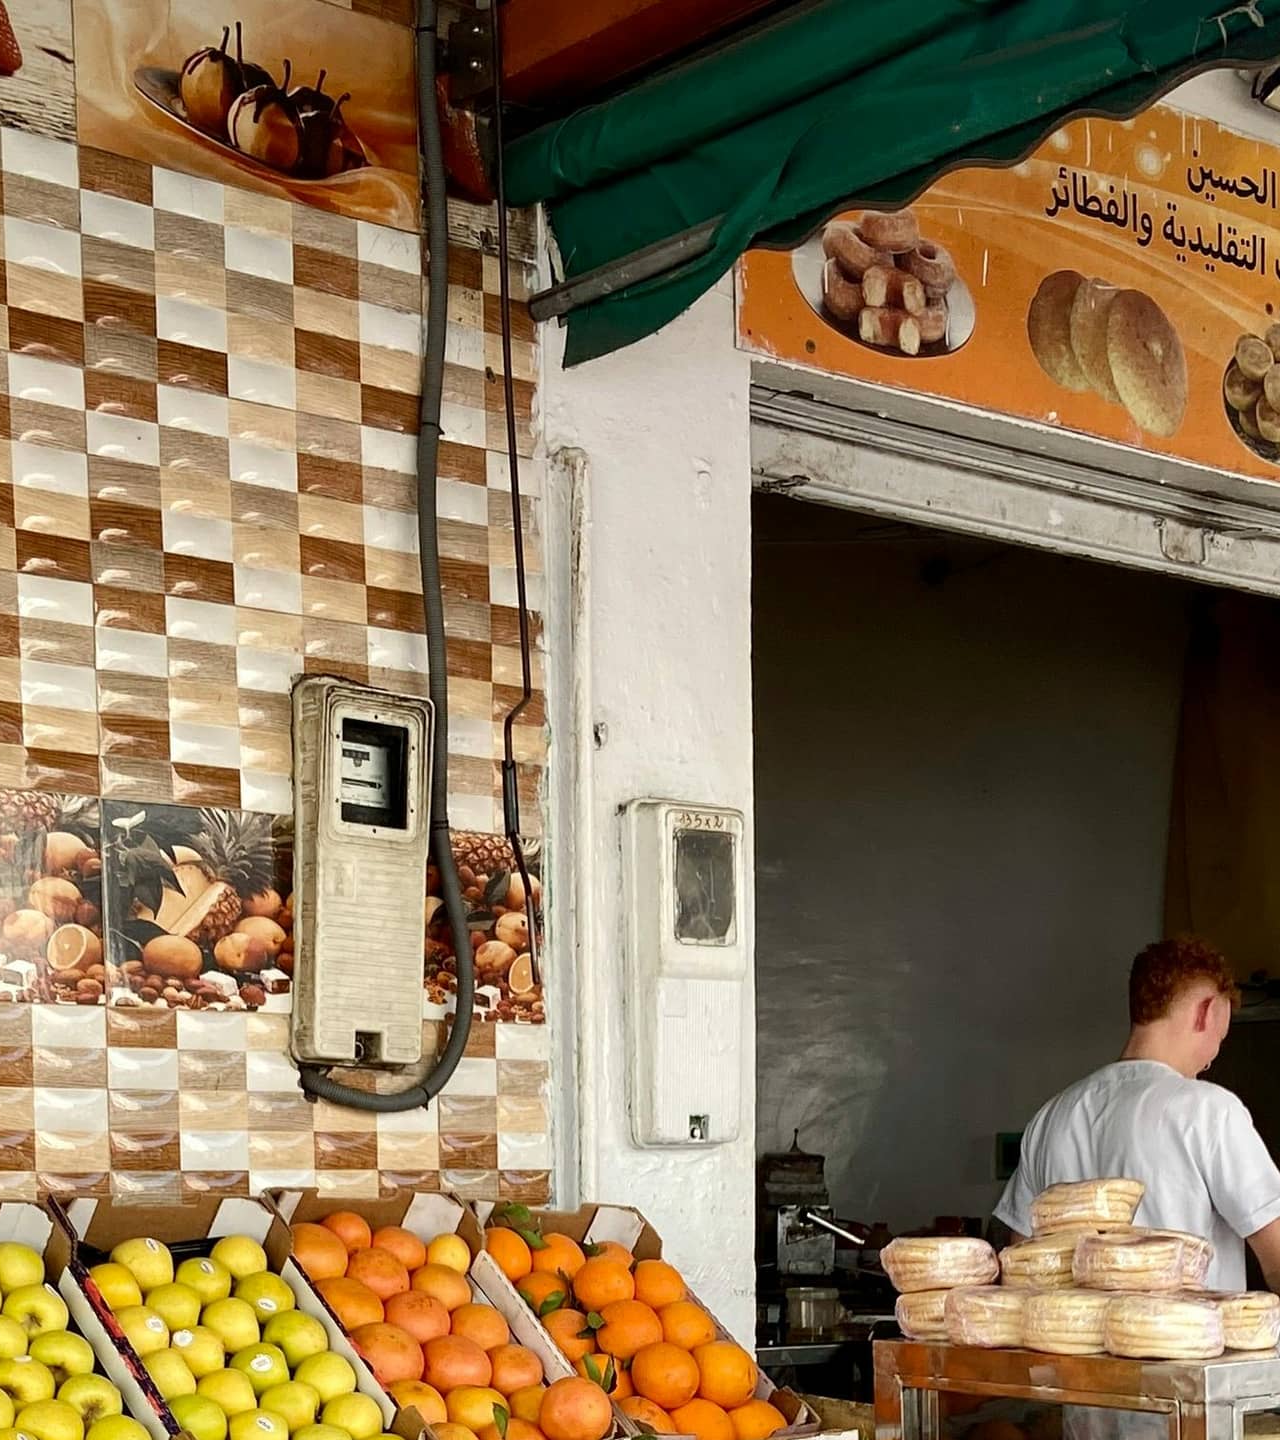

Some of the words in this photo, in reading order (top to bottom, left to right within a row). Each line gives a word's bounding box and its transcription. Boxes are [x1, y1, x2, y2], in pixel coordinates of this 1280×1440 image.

[1045, 166, 1153, 246] والفطائر
[1187, 150, 1276, 209] الحسين
[1163, 202, 1265, 275] التقليدية
